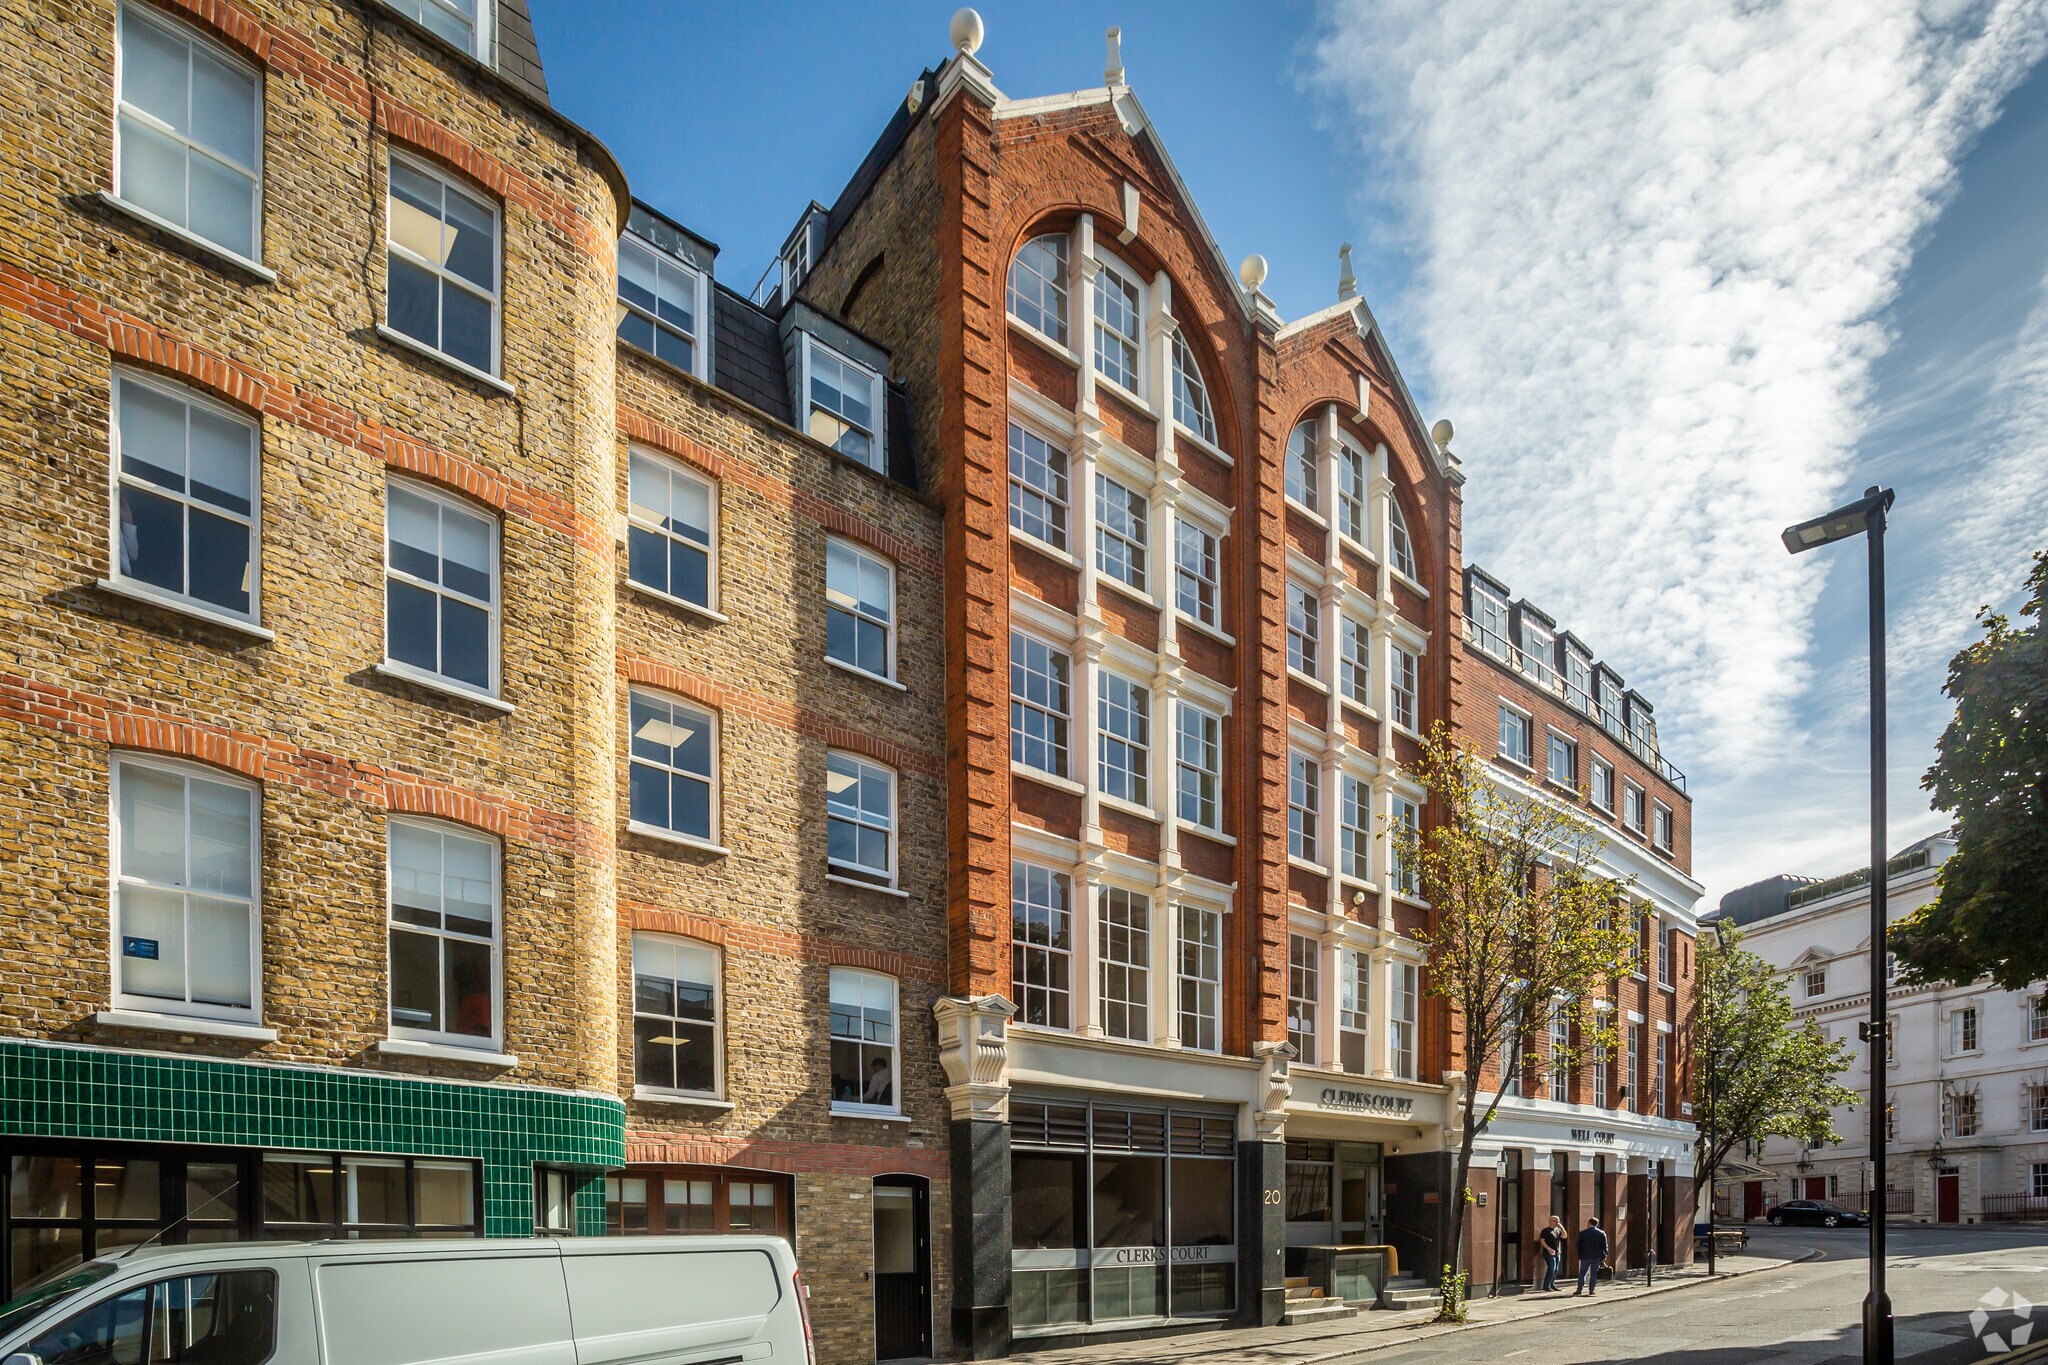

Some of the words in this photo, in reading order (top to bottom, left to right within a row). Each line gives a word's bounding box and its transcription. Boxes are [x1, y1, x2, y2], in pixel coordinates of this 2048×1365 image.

[1323, 1088, 1372, 1108] CLERKS
[1373, 1094, 1414, 1112] COURT
[1571, 1128, 1591, 1141] WELL
[1594, 1131, 1616, 1144] COURT
[1264, 1189, 1281, 1205] 20
[1117, 1248, 1166, 1263] CLERKS
[1170, 1246, 1210, 1260] COURT
